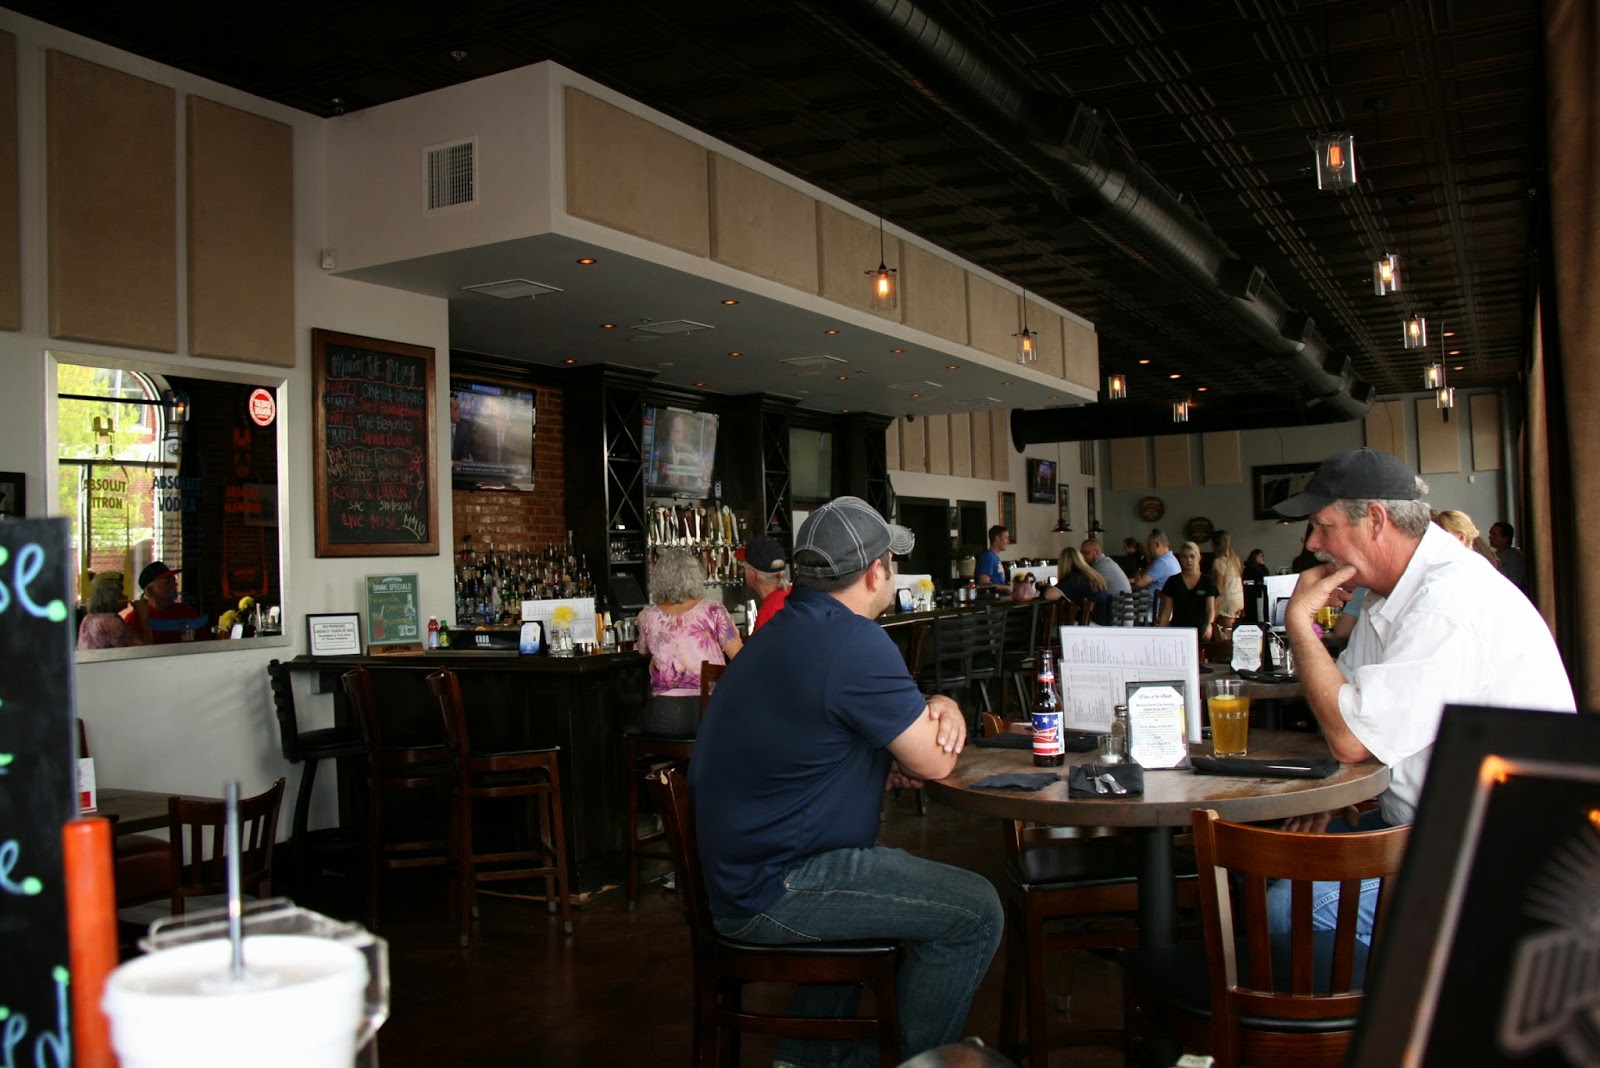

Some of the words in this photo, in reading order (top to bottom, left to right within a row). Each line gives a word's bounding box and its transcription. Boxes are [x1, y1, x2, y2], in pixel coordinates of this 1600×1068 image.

[331, 353, 364, 379] Main
[386, 358, 416, 387] May
[152, 475, 201, 491] ABSOLUT
[88, 496, 123, 509] ITRON
[158, 496, 199, 513] VODKA
[379, 499, 412, 513] SIMPSON
[389, 583, 412, 591] SPECIALS
